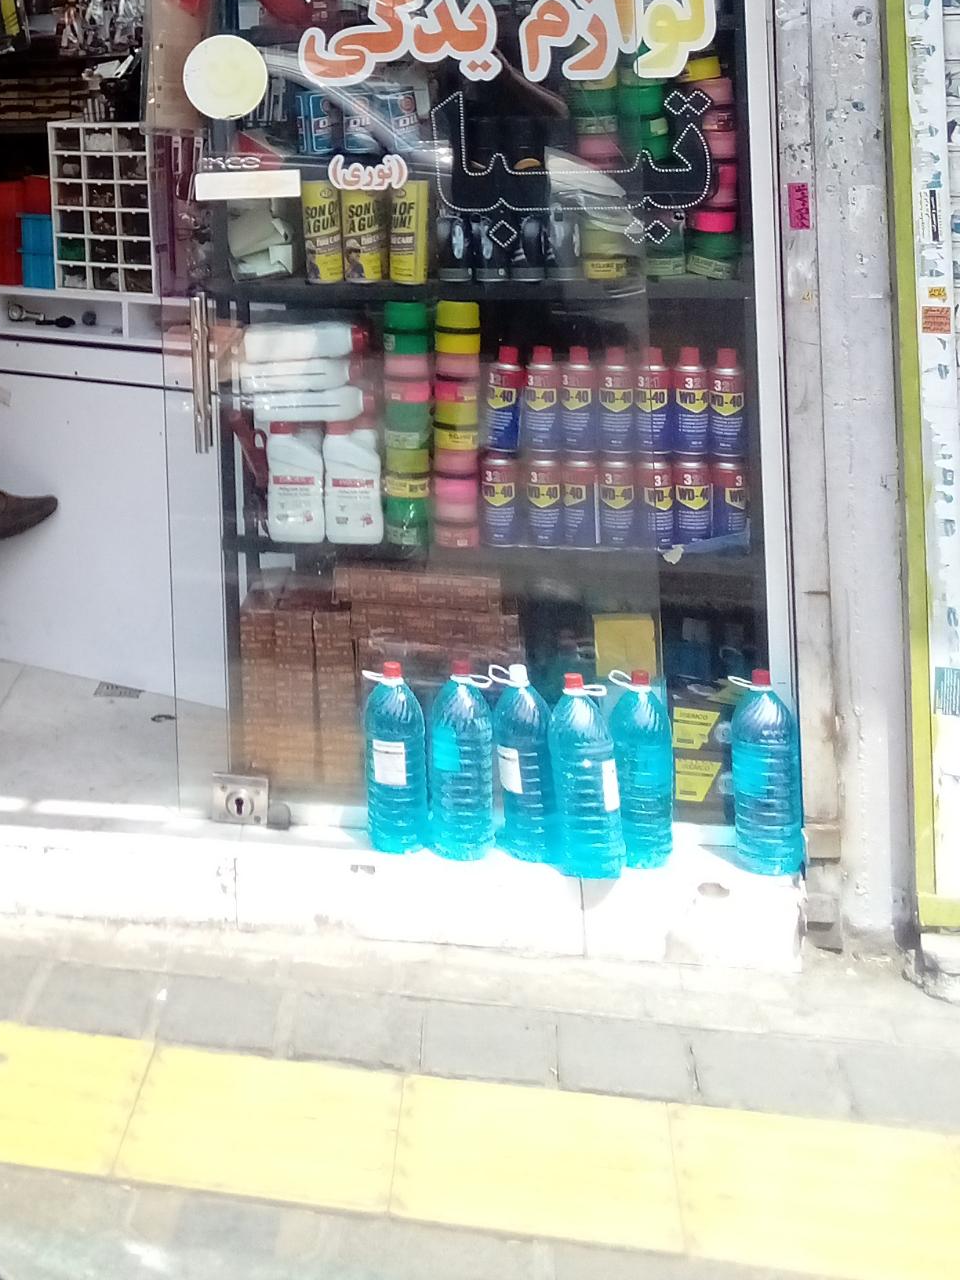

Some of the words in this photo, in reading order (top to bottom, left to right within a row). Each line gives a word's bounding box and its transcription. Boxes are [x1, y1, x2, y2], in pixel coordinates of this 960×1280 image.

[328, 154, 408, 190] (نوری)
[305, 204, 327, 220] SON
[348, 201, 372, 218] SON
